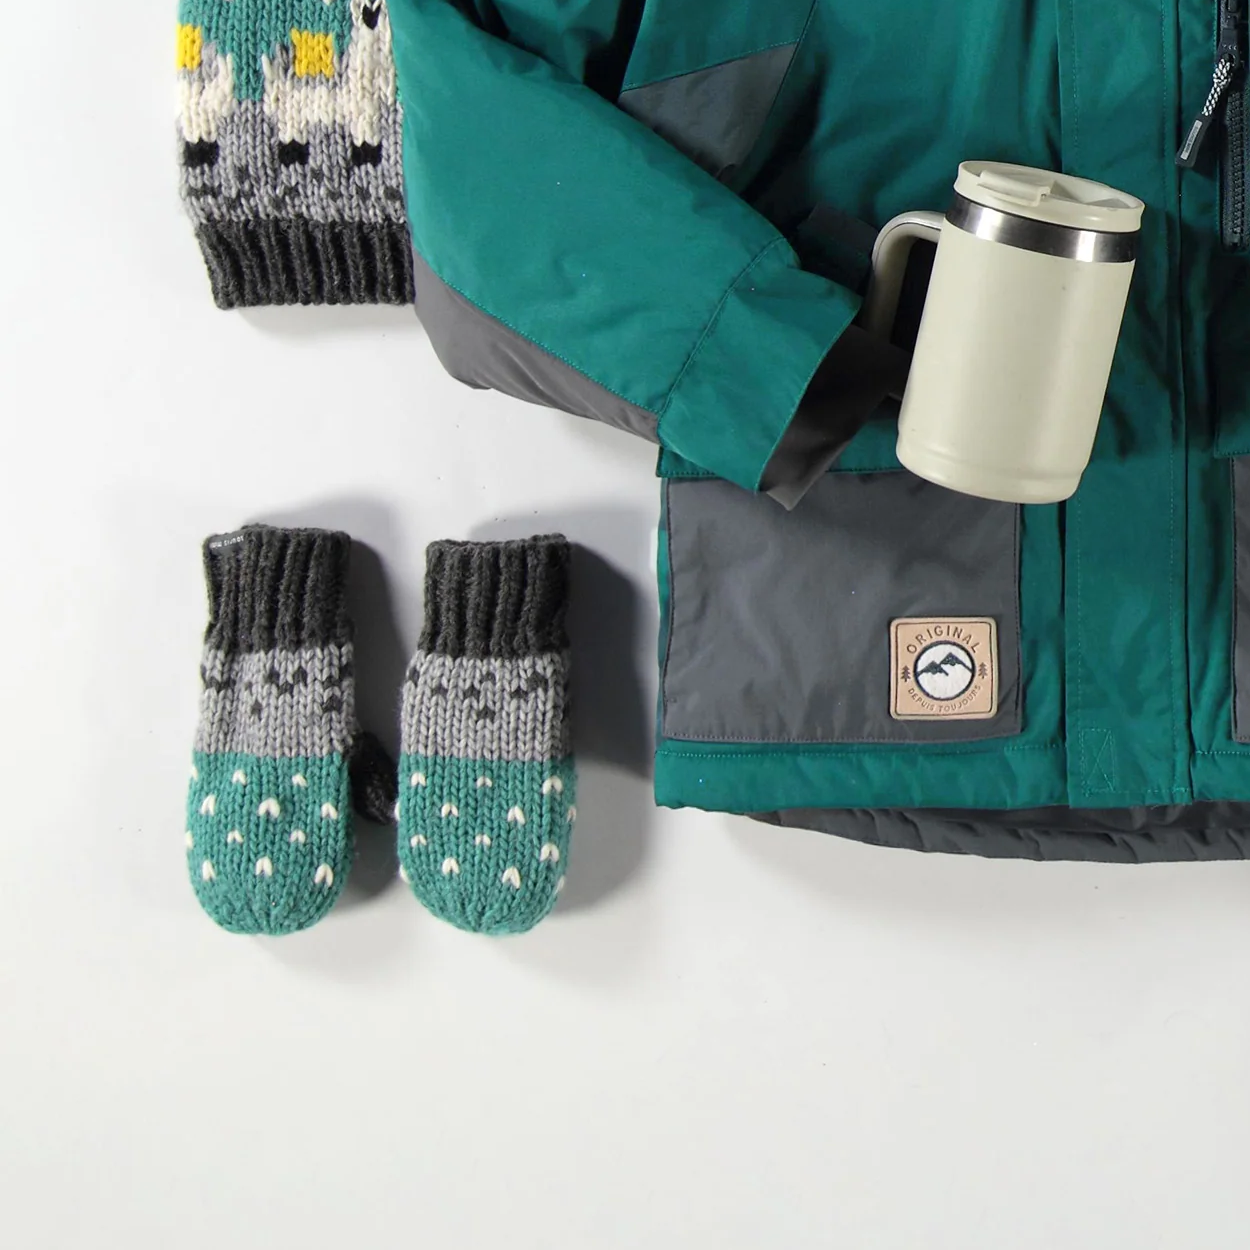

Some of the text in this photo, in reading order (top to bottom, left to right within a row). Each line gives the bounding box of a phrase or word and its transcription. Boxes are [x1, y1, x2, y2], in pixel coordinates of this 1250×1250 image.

[906, 624, 981, 655] ORIGINAL
[908, 684, 982, 713] DEPUIS TOUJOURS
